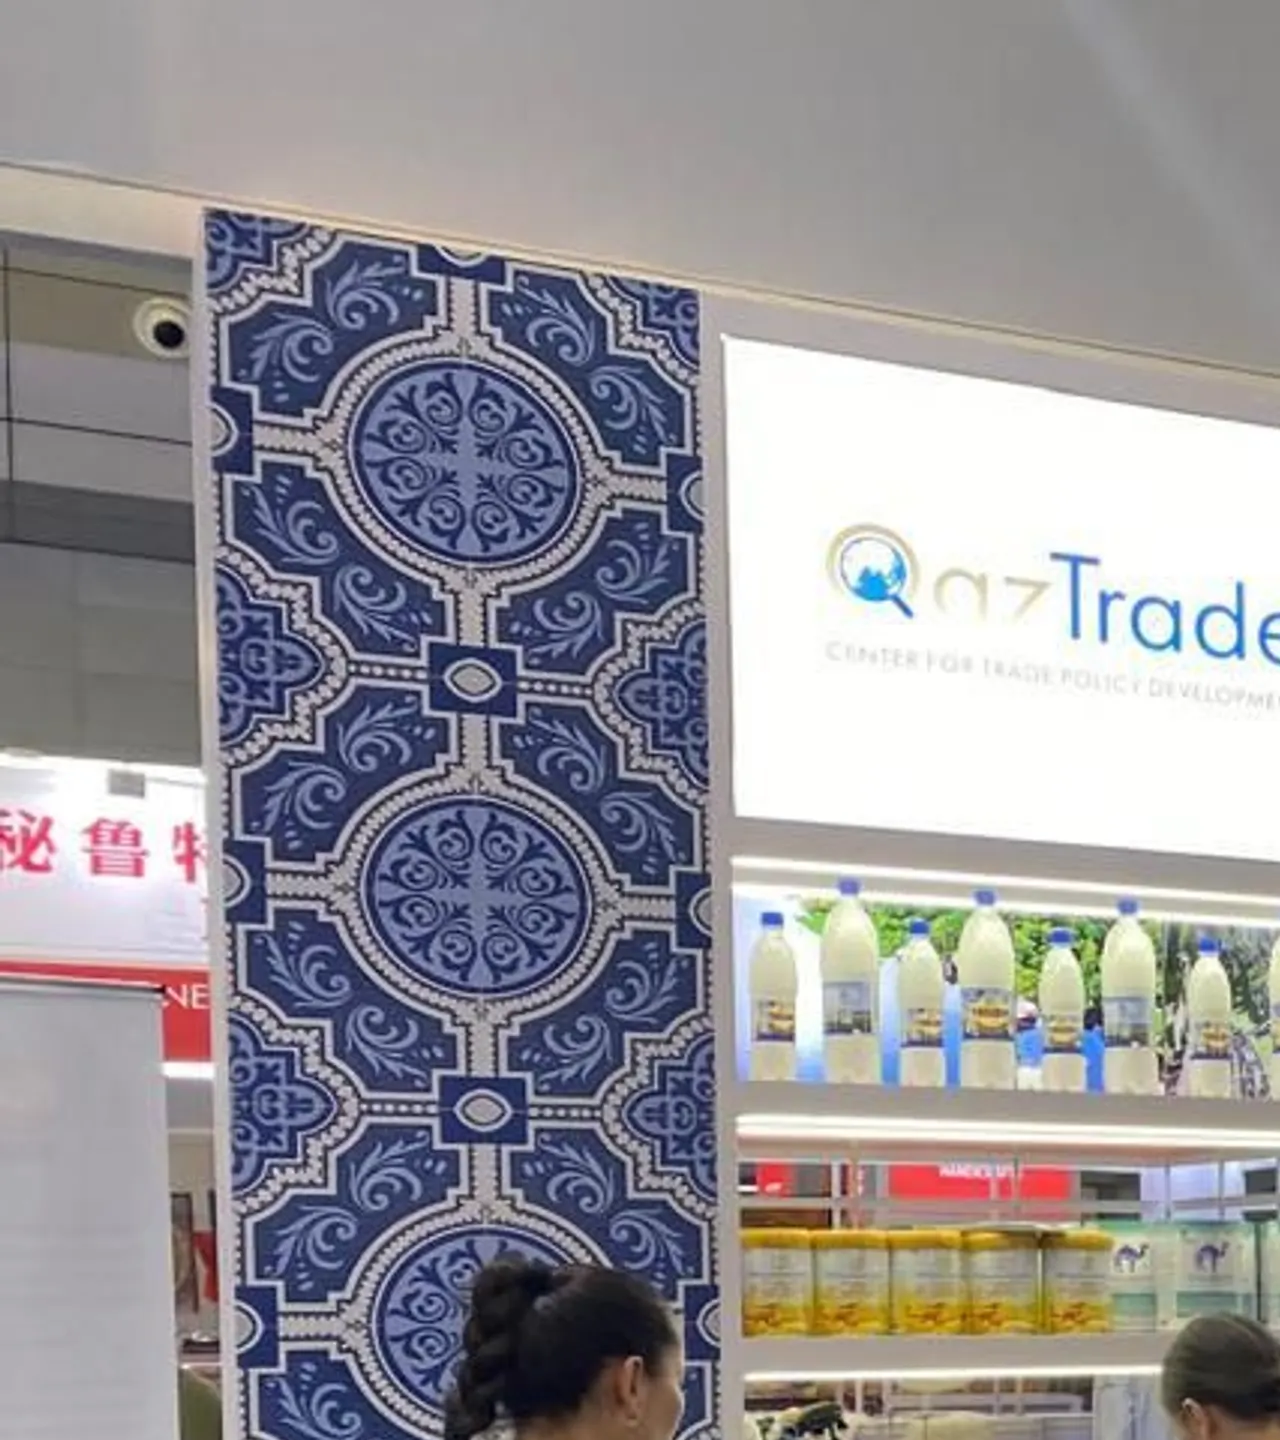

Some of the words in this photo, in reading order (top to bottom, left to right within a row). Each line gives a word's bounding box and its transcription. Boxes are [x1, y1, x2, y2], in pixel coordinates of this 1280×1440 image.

[825, 641, 918, 670] CENTER
[926, 648, 973, 675] FOR
[982, 657, 1053, 686] TRADE
[1061, 667, 1139, 697] POLICY
